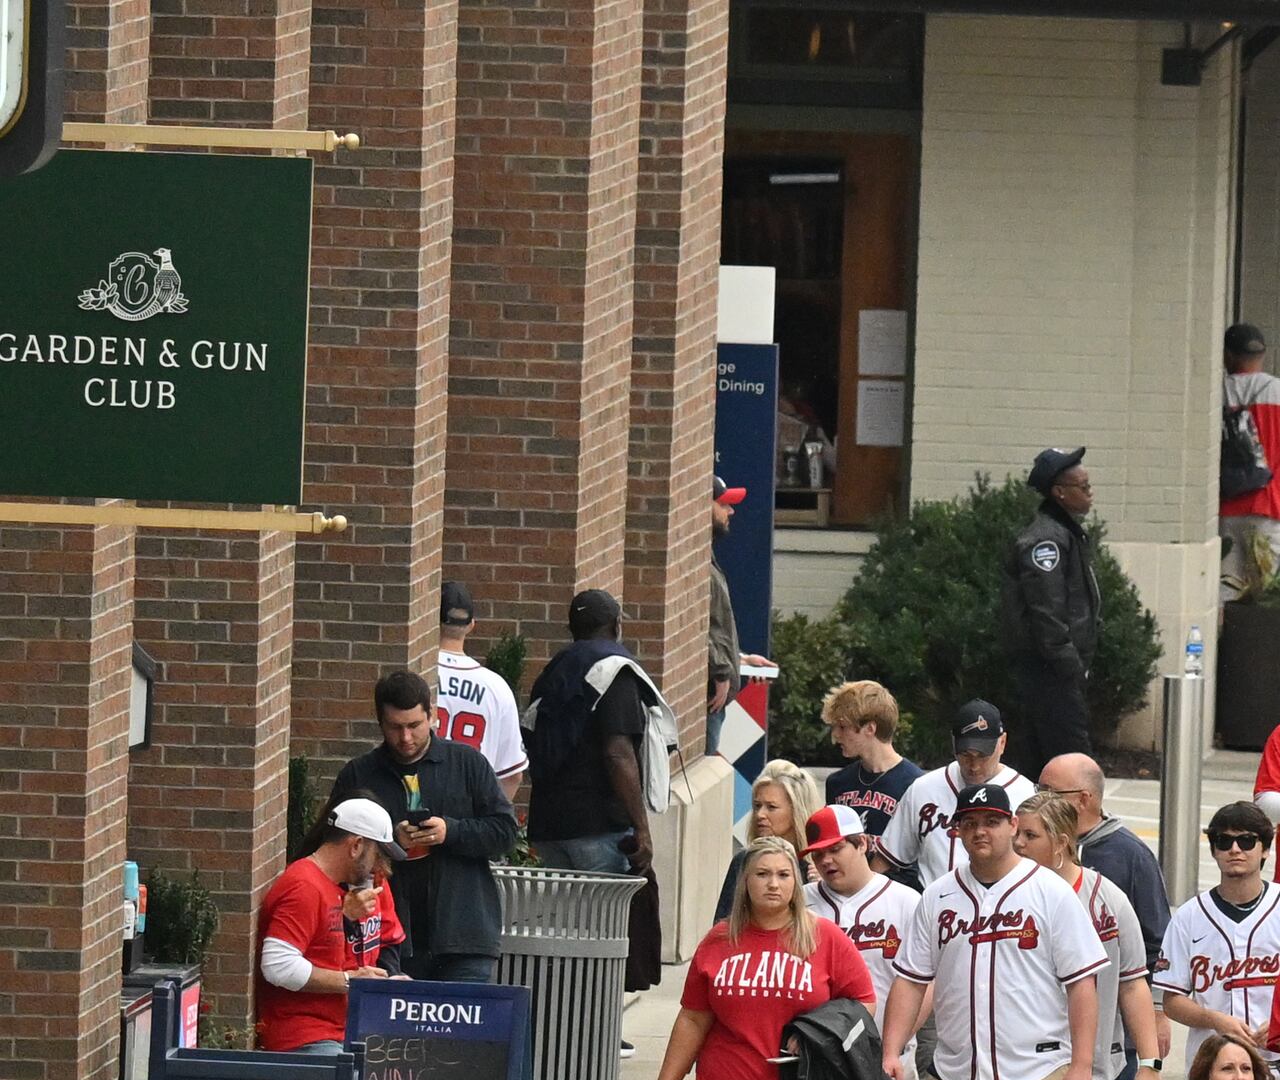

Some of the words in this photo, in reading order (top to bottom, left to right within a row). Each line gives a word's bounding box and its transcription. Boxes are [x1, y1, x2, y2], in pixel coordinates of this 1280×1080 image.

[0, 333, 147, 367] GARDEN
[158, 339, 181, 368] &
[190, 340, 268, 372] GUN
[84, 378, 176, 409] CLUB
[719, 378, 765, 395] Dining
[438, 676, 486, 706] LSON
[969, 787, 988, 803] A
[937, 908, 1024, 949] Braves
[713, 951, 813, 994] ATLANTA
[717, 988, 805, 1001] BASEBALL
[389, 998, 482, 1025] PERONI
[415, 1024, 453, 1034] ITALIA
